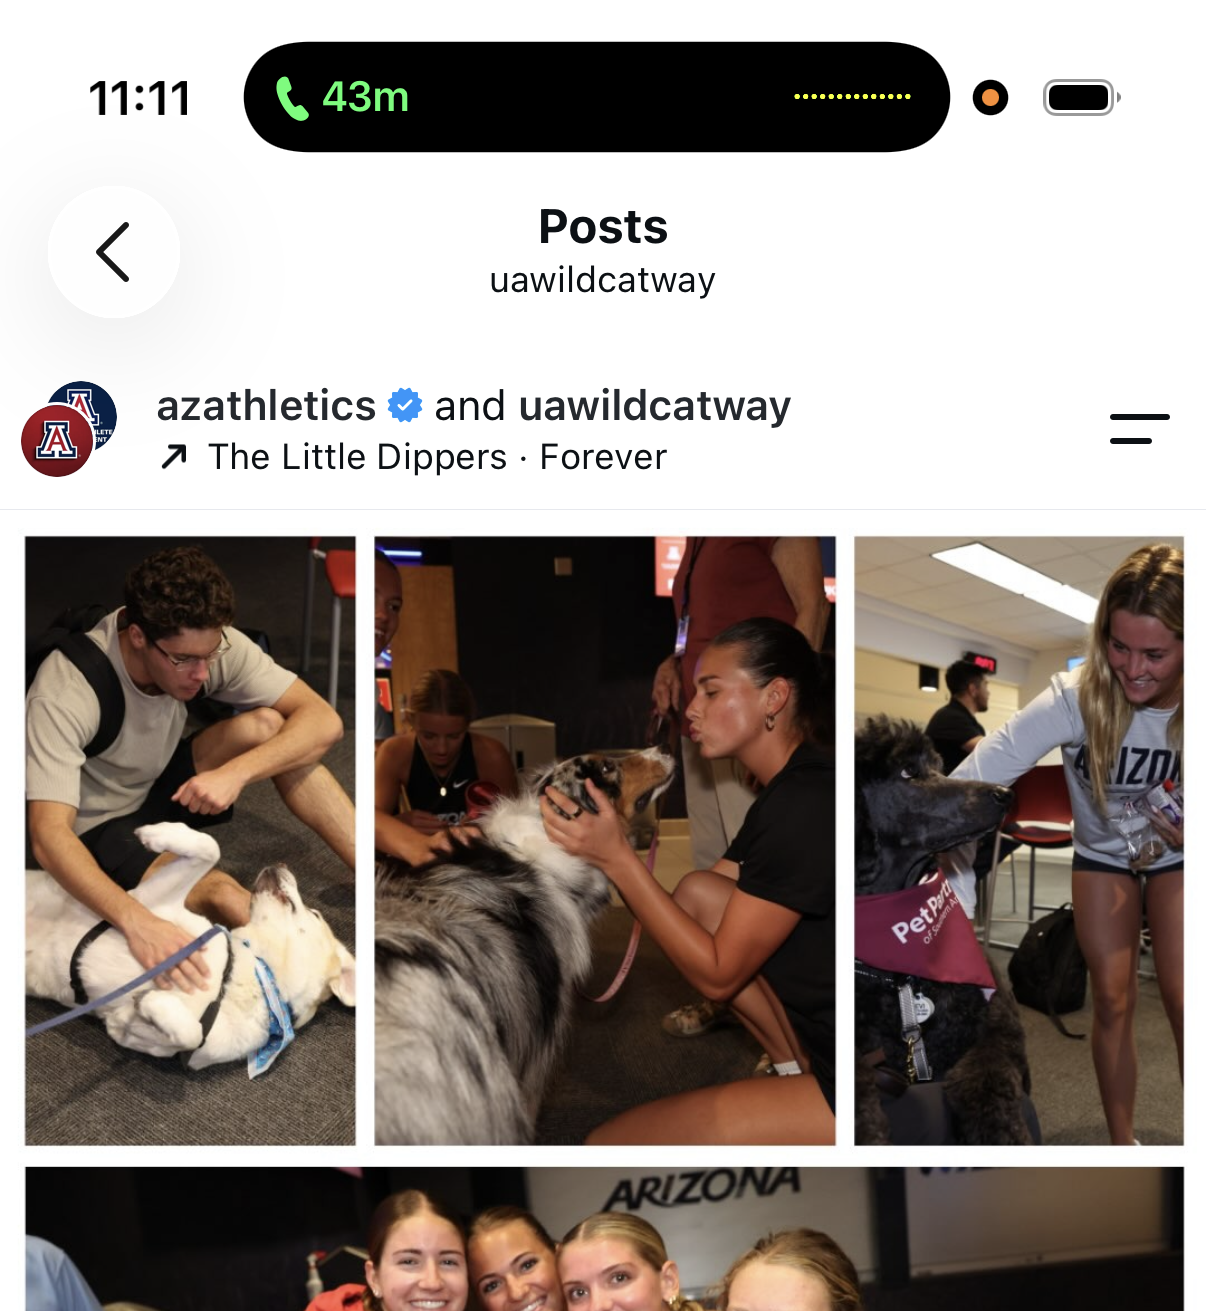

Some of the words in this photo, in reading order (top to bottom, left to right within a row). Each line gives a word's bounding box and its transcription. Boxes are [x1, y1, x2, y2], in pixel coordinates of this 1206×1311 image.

[90, 81, 187, 115] 11:11
[323, 81, 407, 112] 43m
[541, 209, 667, 244] Posts
[491, 265, 715, 299] uawildcatway
[158, 388, 375, 420] azathletics
[436, 389, 503, 420] and
[521, 388, 791, 428] uawildcatway
[209, 442, 269, 469] The
[284, 442, 365, 469] Little
[379, 442, 506, 475] Dippers
[542, 444, 667, 469] Forever
[601, 1167, 802, 1212] ARIZONA
